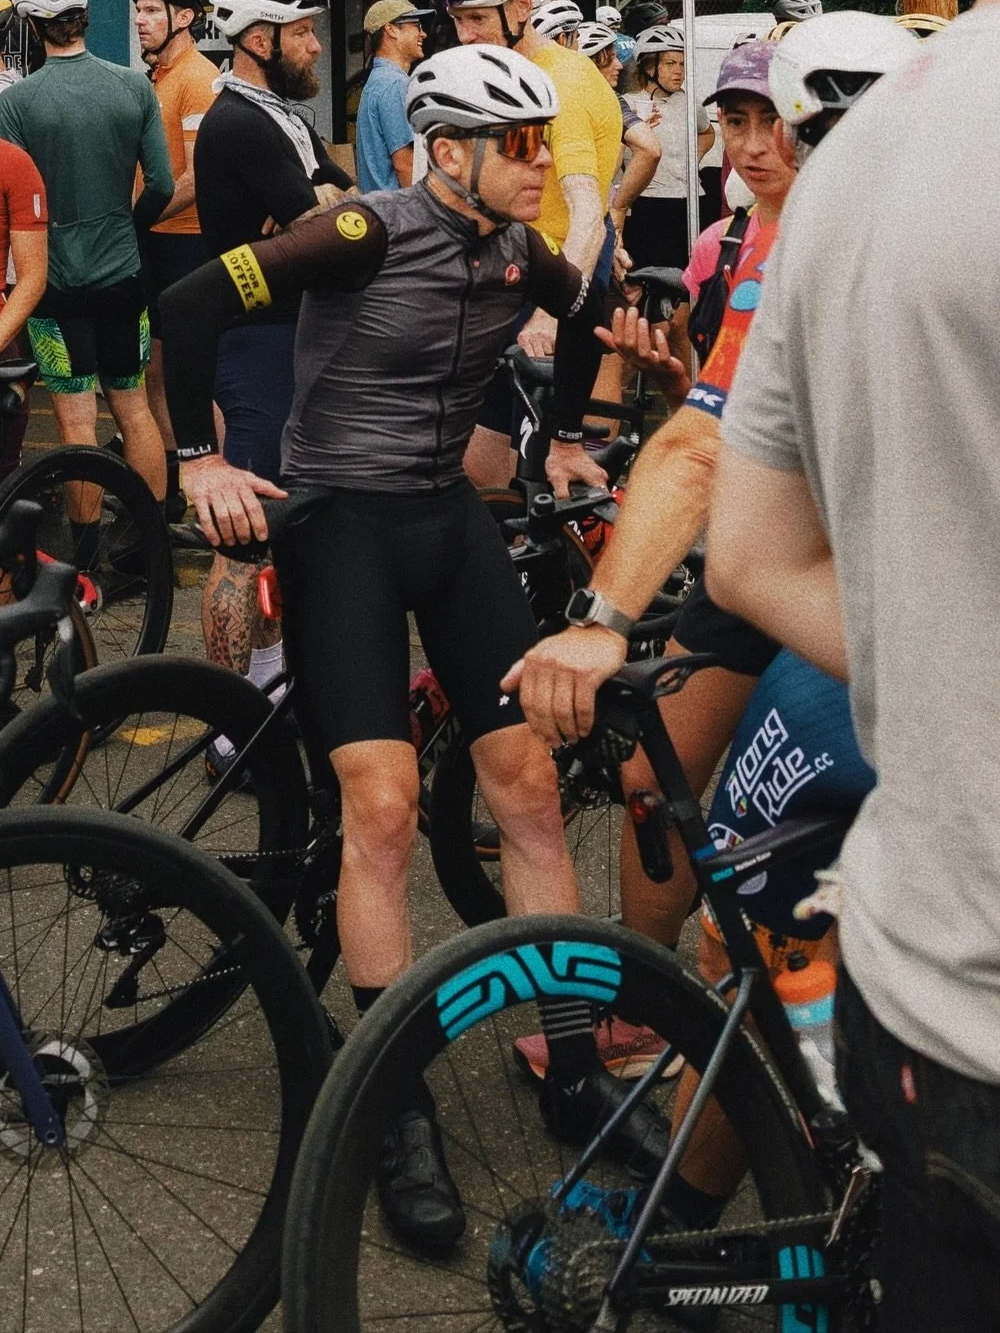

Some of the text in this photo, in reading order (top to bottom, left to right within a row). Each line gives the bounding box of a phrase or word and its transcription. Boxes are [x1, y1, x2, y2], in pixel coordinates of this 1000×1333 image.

[260, 11, 284, 21] SMITH
[240, 251, 260, 290] MOTOR
[666, 1285, 770, 1307] SPECIALIZED
